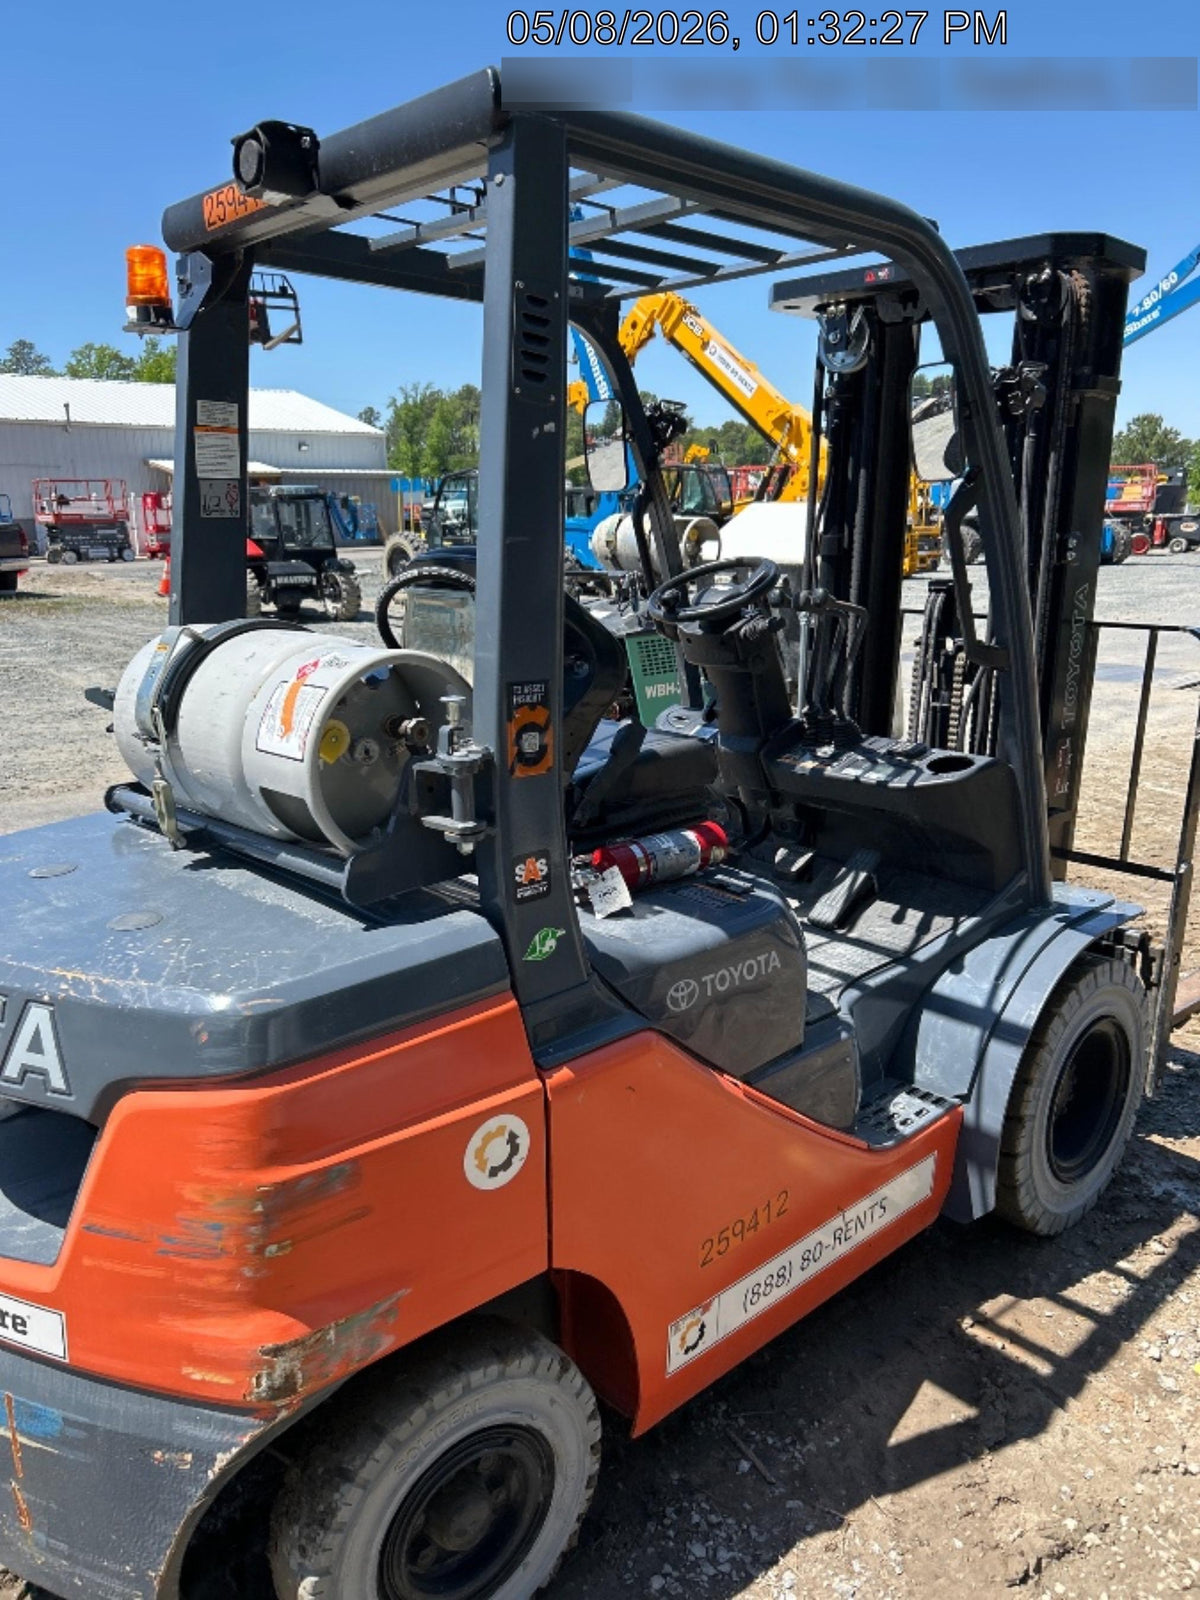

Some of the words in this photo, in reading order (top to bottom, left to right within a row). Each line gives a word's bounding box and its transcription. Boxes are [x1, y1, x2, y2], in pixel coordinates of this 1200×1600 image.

[1061, 583, 1089, 729] TOYOTA
[515, 857, 548, 884] SAS
[702, 950, 781, 996] TOYOTA
[0, 993, 72, 1097] A
[700, 1190, 789, 1268] 259412
[742, 1260, 793, 1313] (888)
[800, 1196, 888, 1272] 80-RENTS
